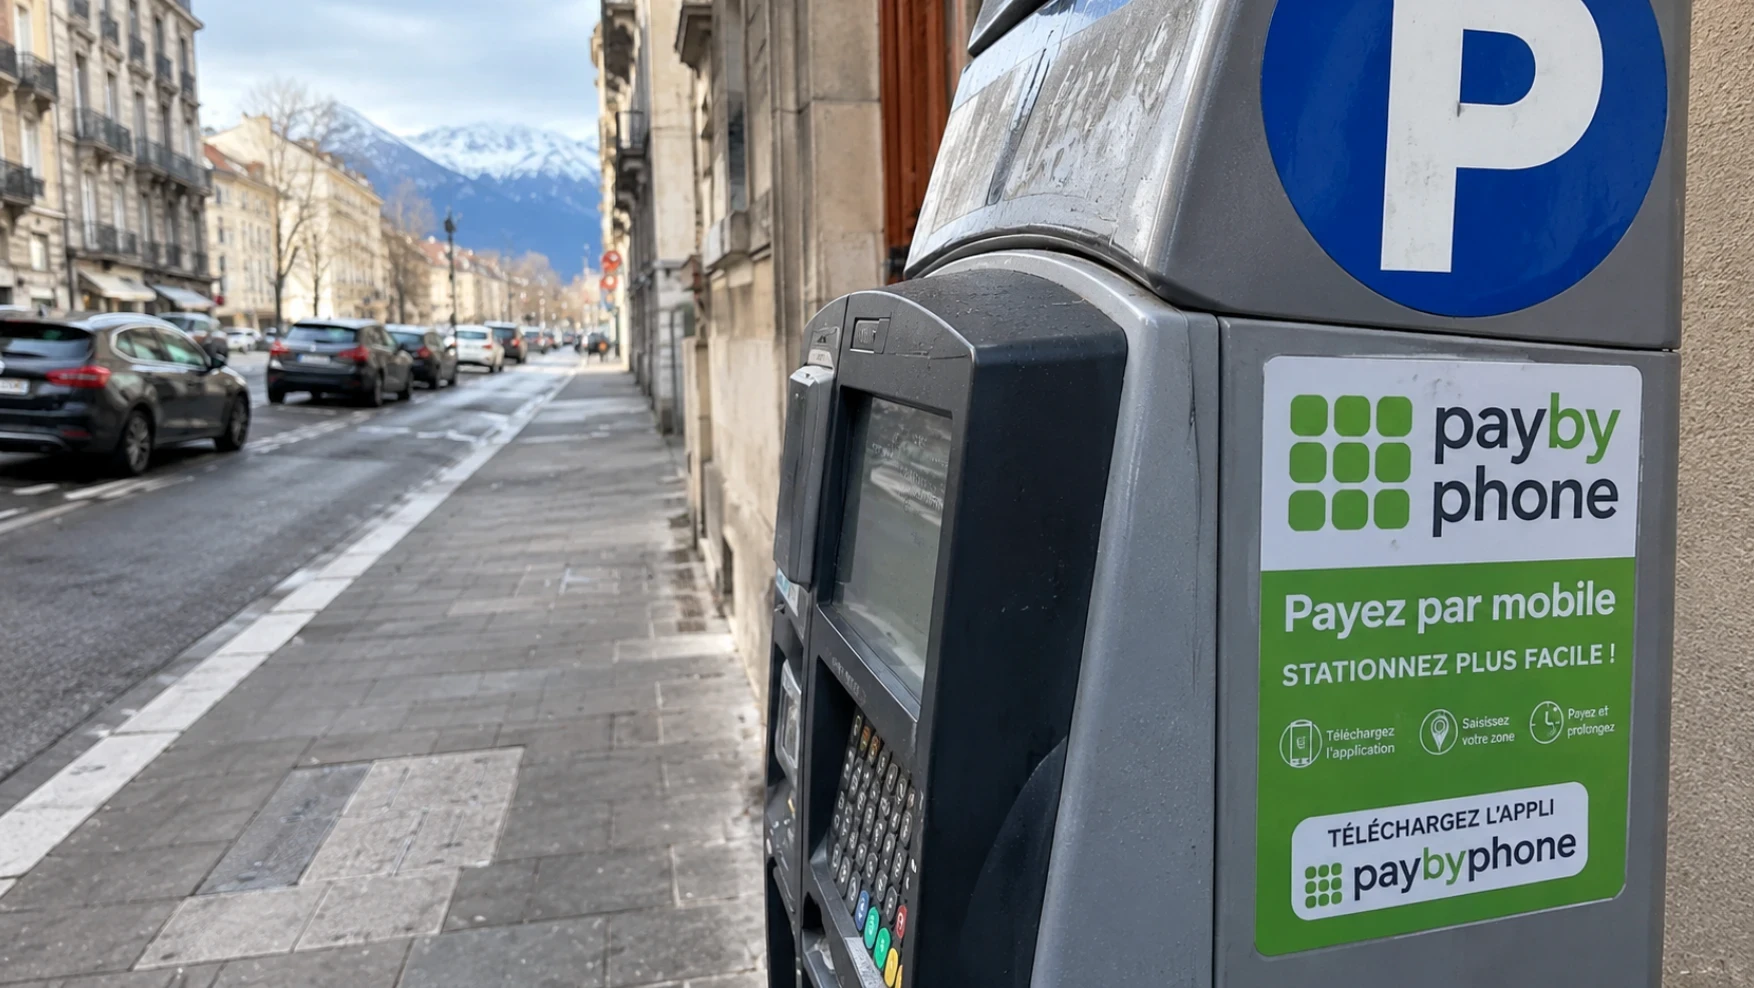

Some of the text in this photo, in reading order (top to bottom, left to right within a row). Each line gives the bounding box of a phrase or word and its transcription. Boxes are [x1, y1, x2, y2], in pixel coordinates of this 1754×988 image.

[1380, 0, 1604, 273] P
[1434, 392, 1621, 464] payby
[1432, 465, 1619, 537] phone
[1284, 579, 1615, 639] Payez par mobile
[1282, 643, 1615, 687] STATIONNEZ PLUS FACILE !
[1326, 727, 1395, 741] Téléchargez
[1462, 716, 1510, 729] Saisissez
[1598, 705, 1609, 717] et
[1326, 743, 1395, 760] l'application
[1462, 731, 1516, 746] votre zone
[1328, 799, 1554, 847] TÉLÉCHARGEZ L'APPLI
[1353, 833, 1576, 901] paybyphone
